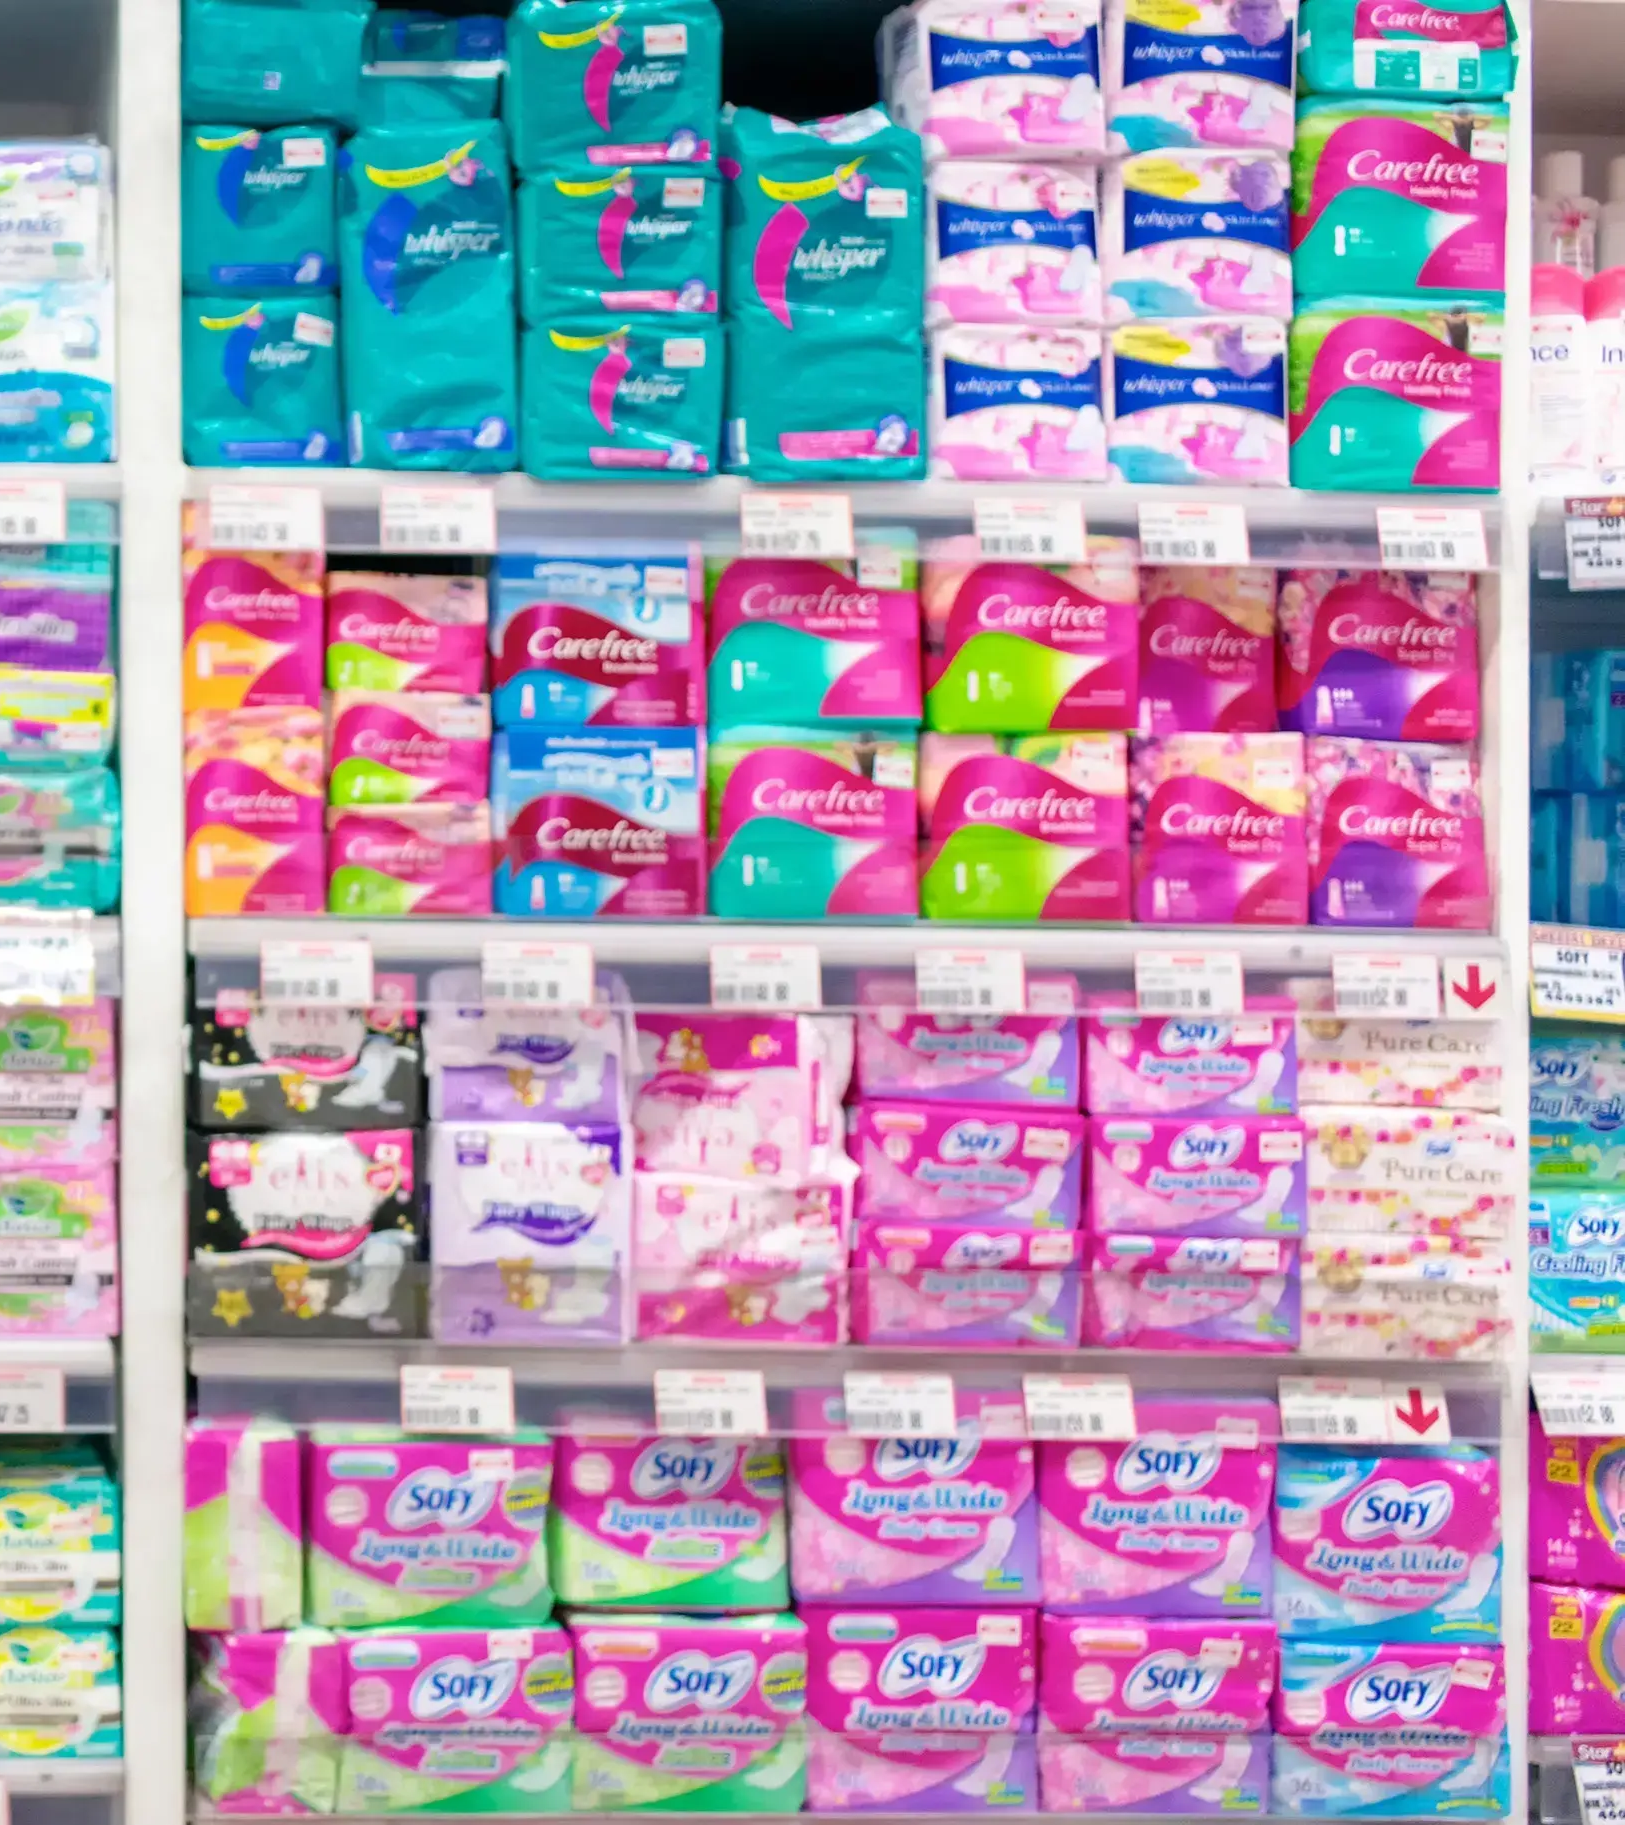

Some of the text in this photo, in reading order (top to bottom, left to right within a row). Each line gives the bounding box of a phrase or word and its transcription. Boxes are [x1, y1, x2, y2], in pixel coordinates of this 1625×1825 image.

[1370, 5, 1460, 31] Carefree
[613, 63, 680, 91] whisper
[1347, 149, 1479, 183] Carefree
[404, 224, 500, 261] whisper
[626, 219, 692, 243] whisper
[795, 240, 887, 276] whisper
[1343, 349, 1472, 383] Carefree
[205, 586, 300, 613] Carefree
[741, 584, 879, 617] Carefree
[977, 593, 1107, 627] Carefree
[339, 614, 440, 642] Carefree
[1150, 625, 1260, 657] Carefree
[1328, 613, 1457, 646] Carefree
[527, 627, 658, 662] Carefree
[352, 729, 451, 759] Carefree
[205, 787, 298, 812] Carefree
[752, 779, 886, 812] Carefree
[963, 786, 1096, 820] Carefree
[537, 817, 668, 852] Carefree
[1161, 803, 1285, 837] Carefree
[1339, 804, 1463, 837] Carefree
[1175, 1022, 1219, 1042] SOFY
[1183, 1136, 1229, 1158] SOFY
[1381, 1157, 1503, 1184] Pure Care
[1578, 1218, 1621, 1237] SOFY
[894, 1437, 961, 1464] SOFY
[1135, 1448, 1203, 1477] SOFY
[652, 1451, 718, 1484] SOFY
[409, 1484, 474, 1515] SOFY
[1363, 1495, 1432, 1529] SOFY
[666, 1665, 734, 1697] SOFY
[900, 1651, 965, 1682] SOFY
[1145, 1665, 1207, 1694] SOFY
[431, 1672, 497, 1701] SOFY
[1365, 1675, 1431, 1706] SOFY
[1578, 1744, 1612, 1761] Star
